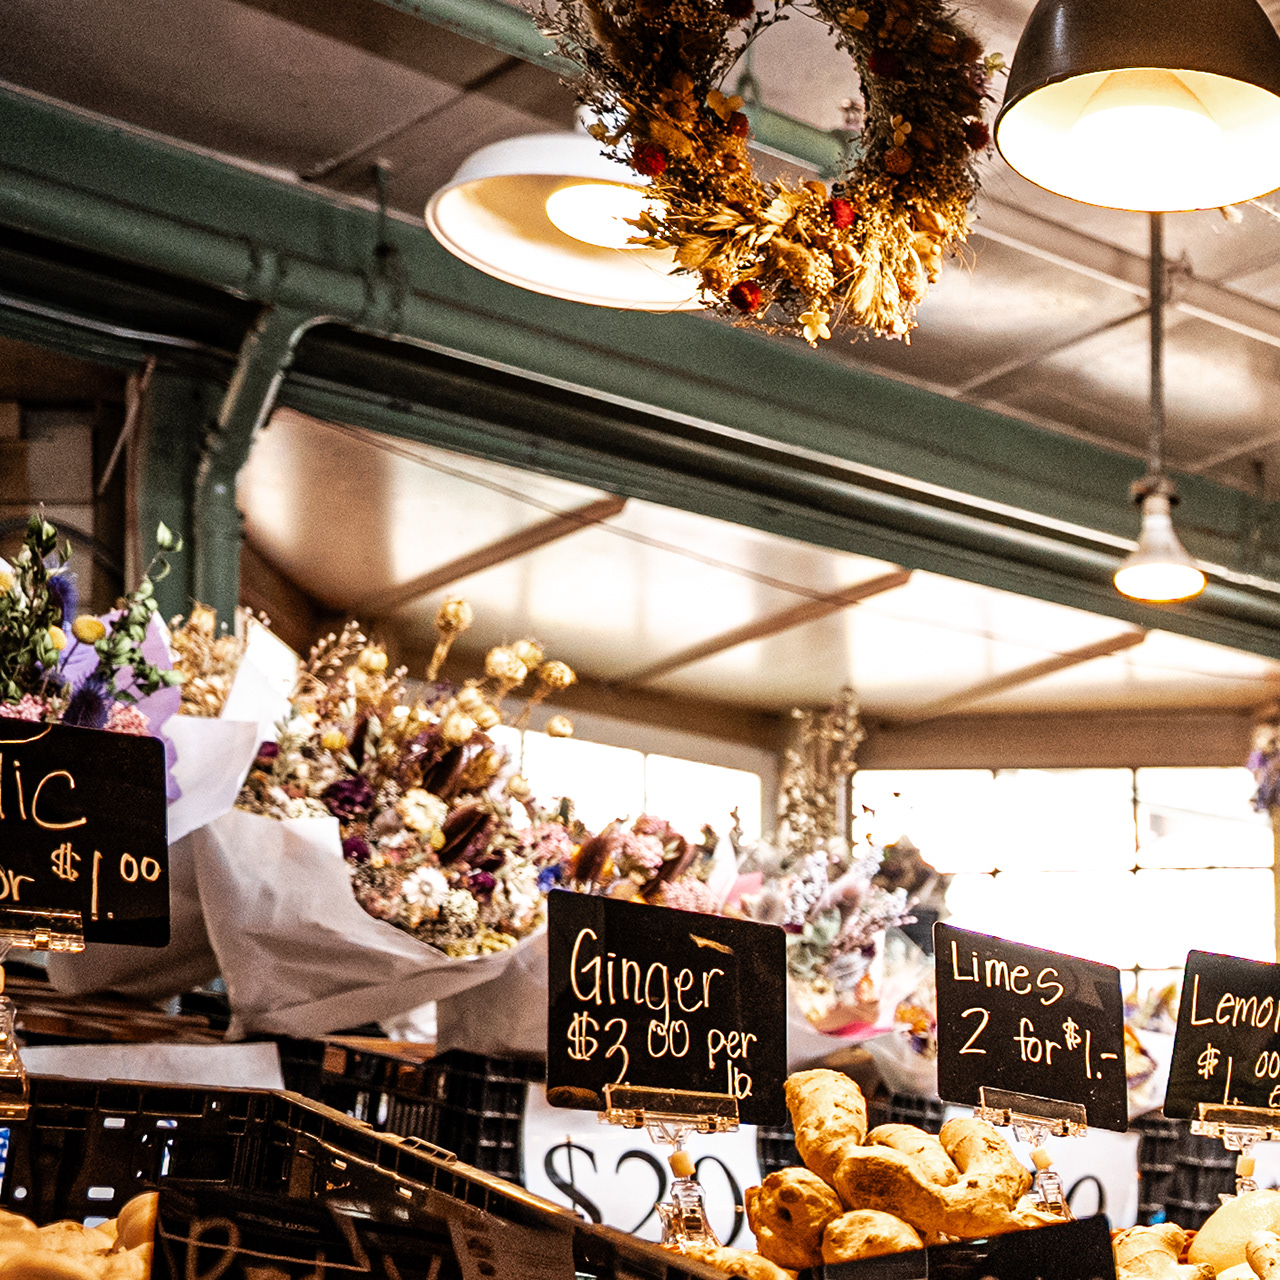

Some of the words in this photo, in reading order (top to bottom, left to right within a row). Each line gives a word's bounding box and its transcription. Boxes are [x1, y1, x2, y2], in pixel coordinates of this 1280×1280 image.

[570, 928, 724, 1030] Ginger
[951, 940, 1065, 1006] Limes
[707, 1028, 758, 1069] per
[959, 1007, 990, 1055] 2
[1013, 1017, 1062, 1065] for
[727, 1059, 753, 1100] lb
